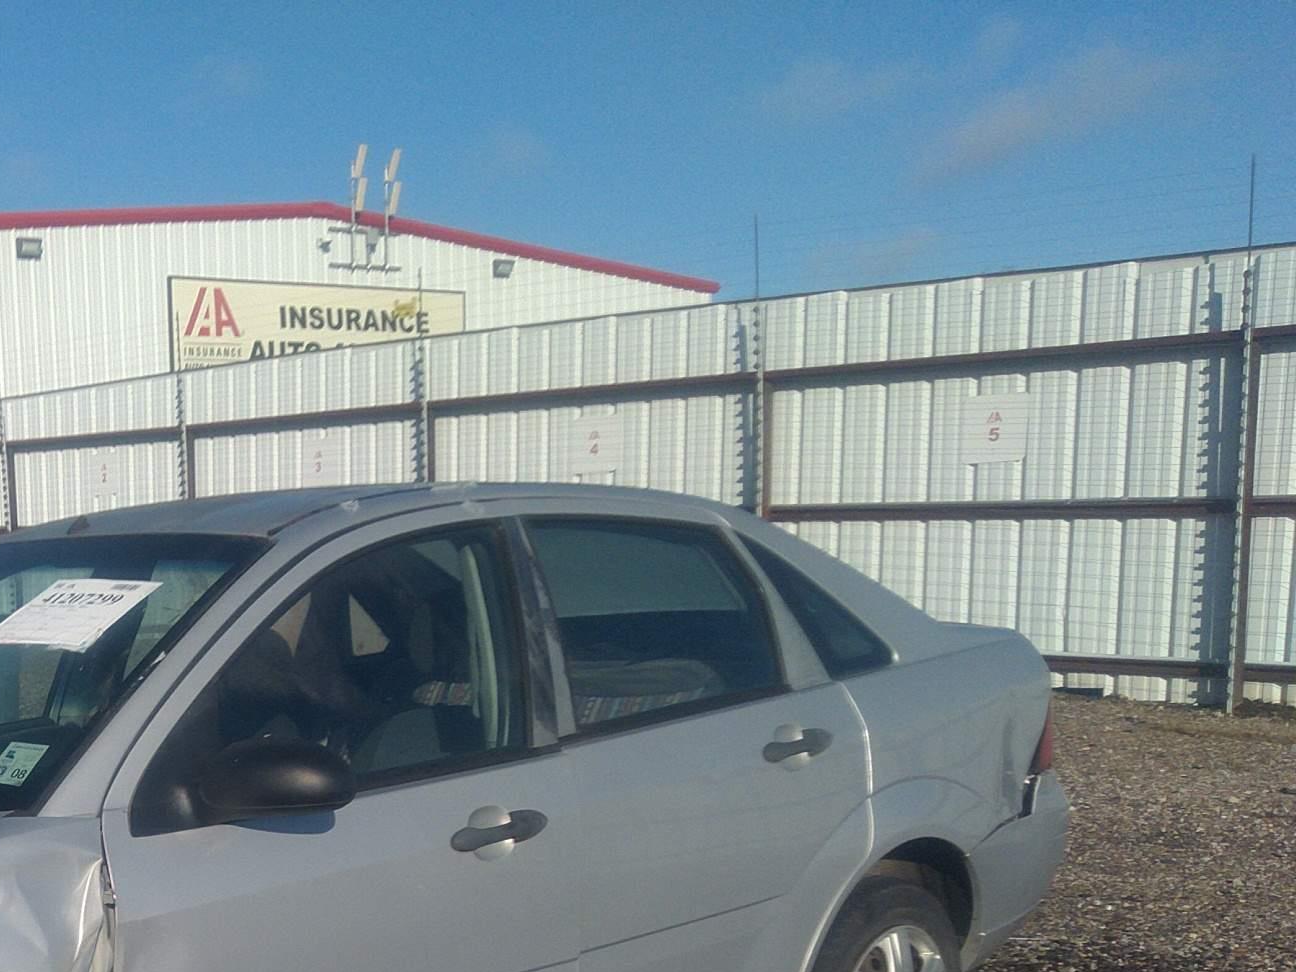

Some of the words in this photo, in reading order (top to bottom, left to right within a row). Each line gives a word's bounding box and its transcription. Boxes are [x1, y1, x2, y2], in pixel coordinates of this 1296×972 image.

[279, 304, 430, 334] INSURANCE
[183, 346, 243, 358] INSURANCE
[988, 427, 1000, 442] 5
[42, 592, 125, 605] 41207299
[10, 768, 28, 779] 08
